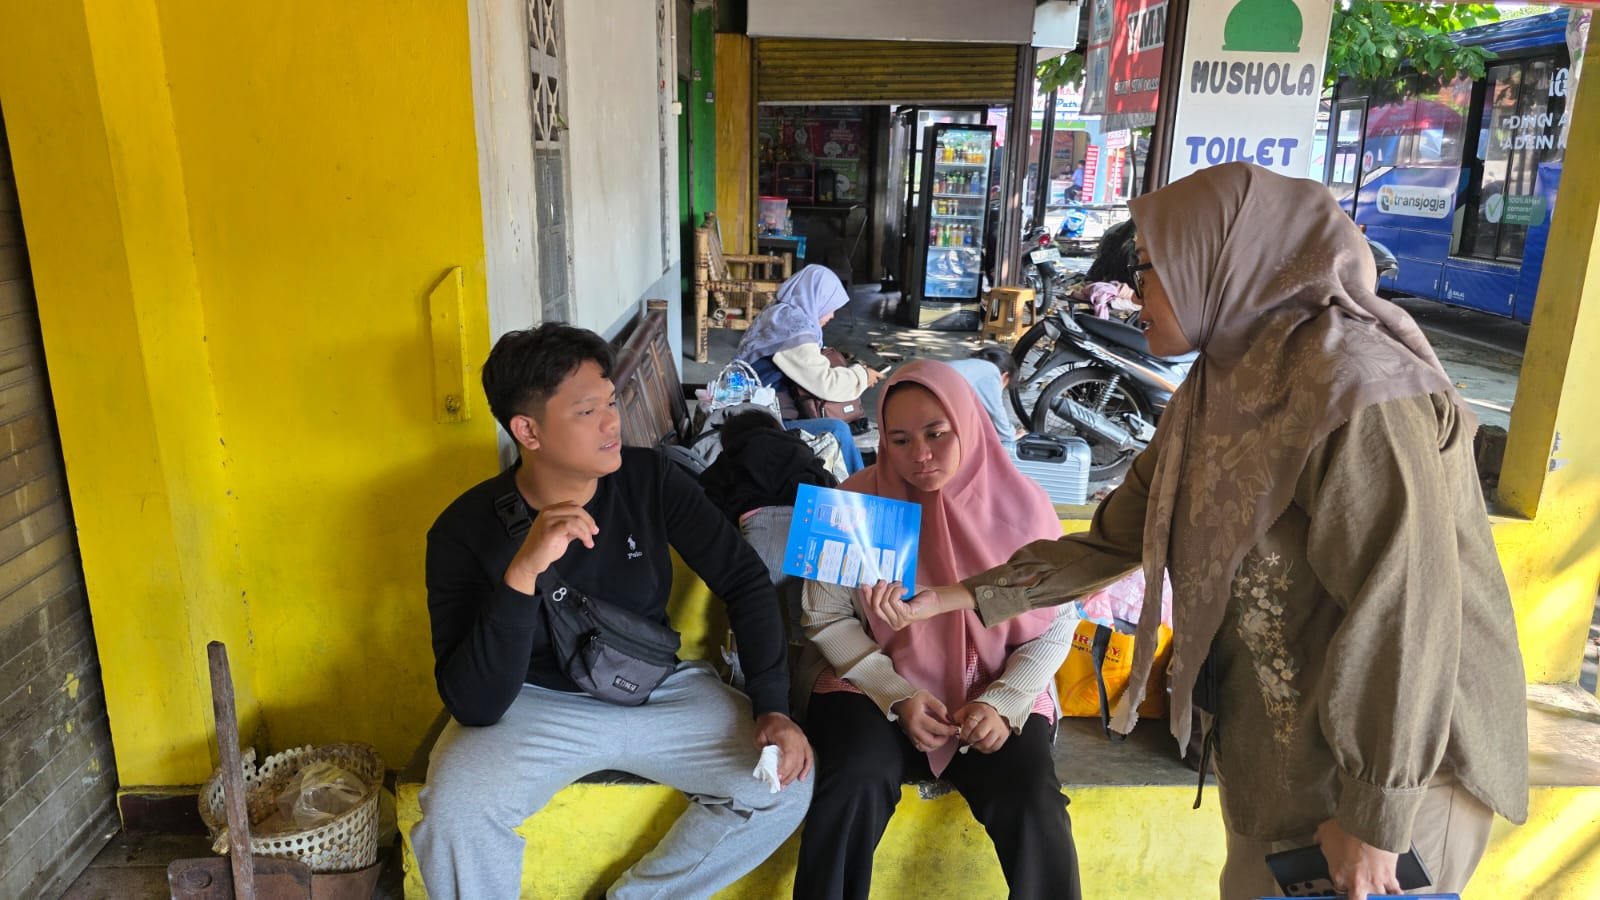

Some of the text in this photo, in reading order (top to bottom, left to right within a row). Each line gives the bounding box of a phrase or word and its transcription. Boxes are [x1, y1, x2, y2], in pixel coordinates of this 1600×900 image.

[1190, 60, 1315, 96] MUSHOLA
[1186, 136, 1299, 166] TOILET
[1394, 192, 1446, 212] transjogja
[626, 551, 643, 560] Polo
